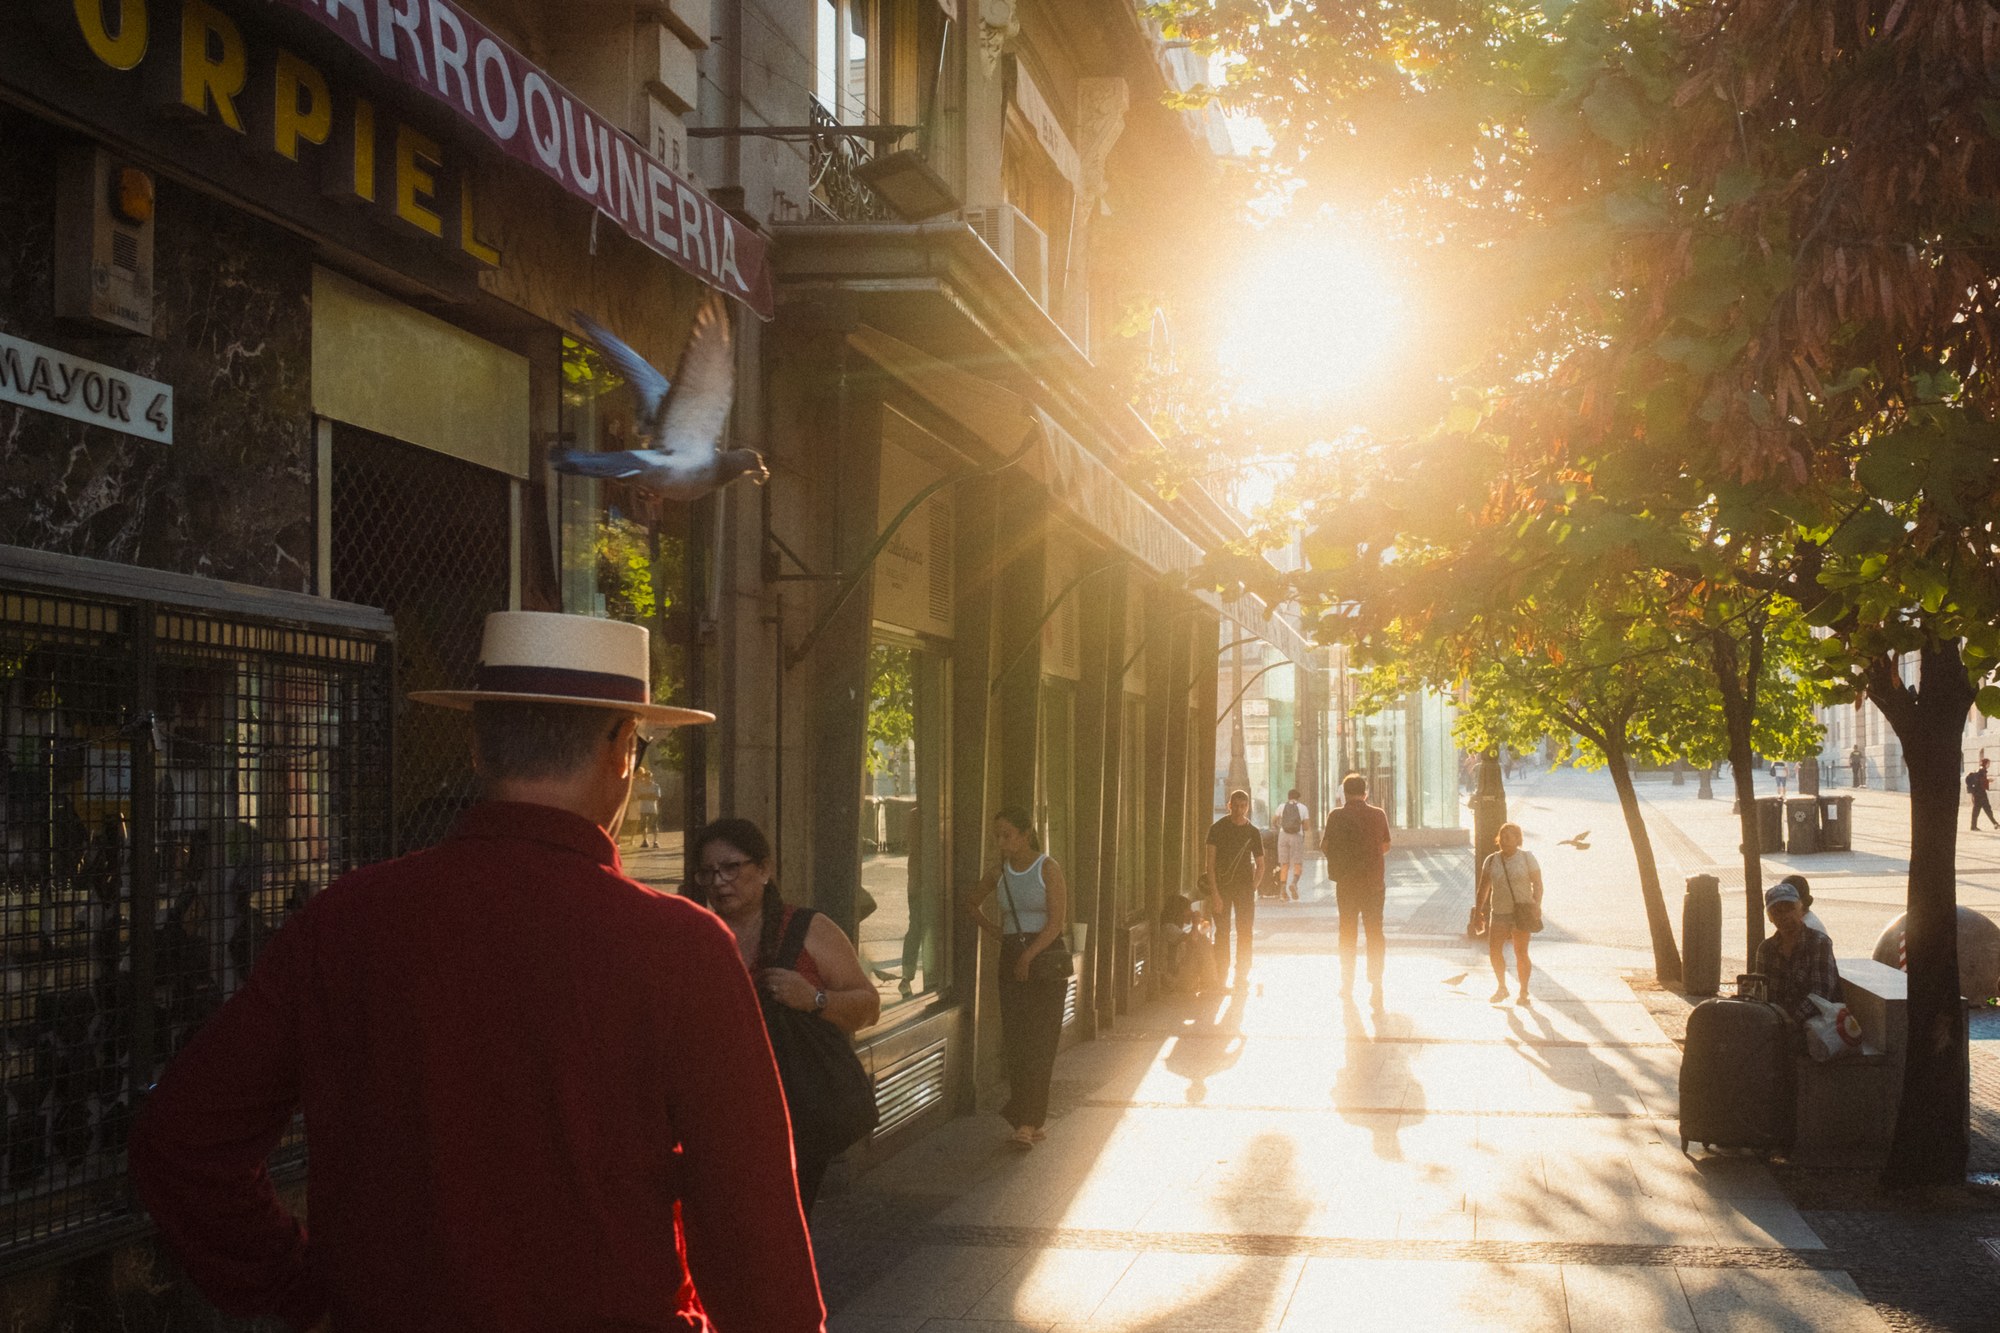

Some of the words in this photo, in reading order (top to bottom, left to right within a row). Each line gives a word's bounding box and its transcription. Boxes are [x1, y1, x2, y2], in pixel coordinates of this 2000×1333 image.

[311, 0, 750, 292] RROQUINERIA
[0, 344, 131, 422] MAYOR
[145, 393, 169, 432] 4
